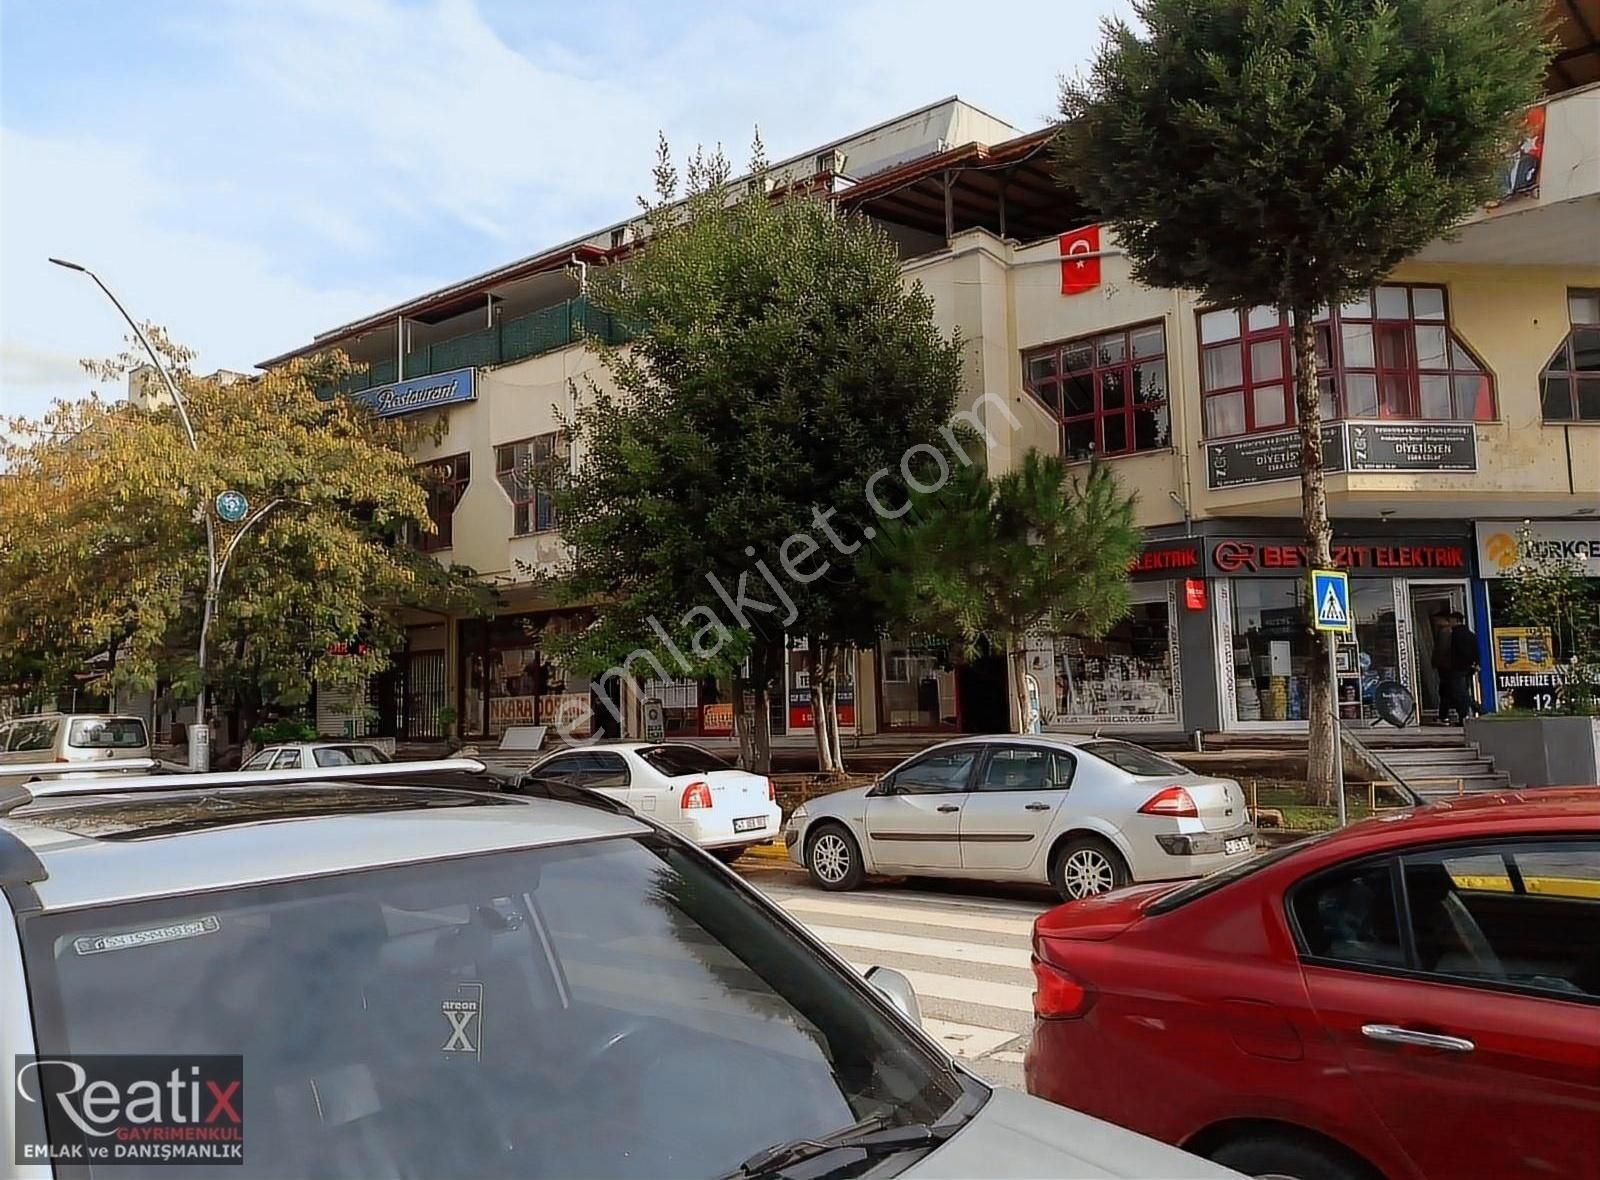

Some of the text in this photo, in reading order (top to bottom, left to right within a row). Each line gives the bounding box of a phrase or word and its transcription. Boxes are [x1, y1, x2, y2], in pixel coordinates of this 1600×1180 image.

[378, 378, 459, 410] Restaurant
[1256, 451, 1299, 466] DİYETİS
[1262, 546, 1367, 568] BEYZIT
[442, 1001, 477, 1010] areon
[442, 1011, 477, 1052] X
